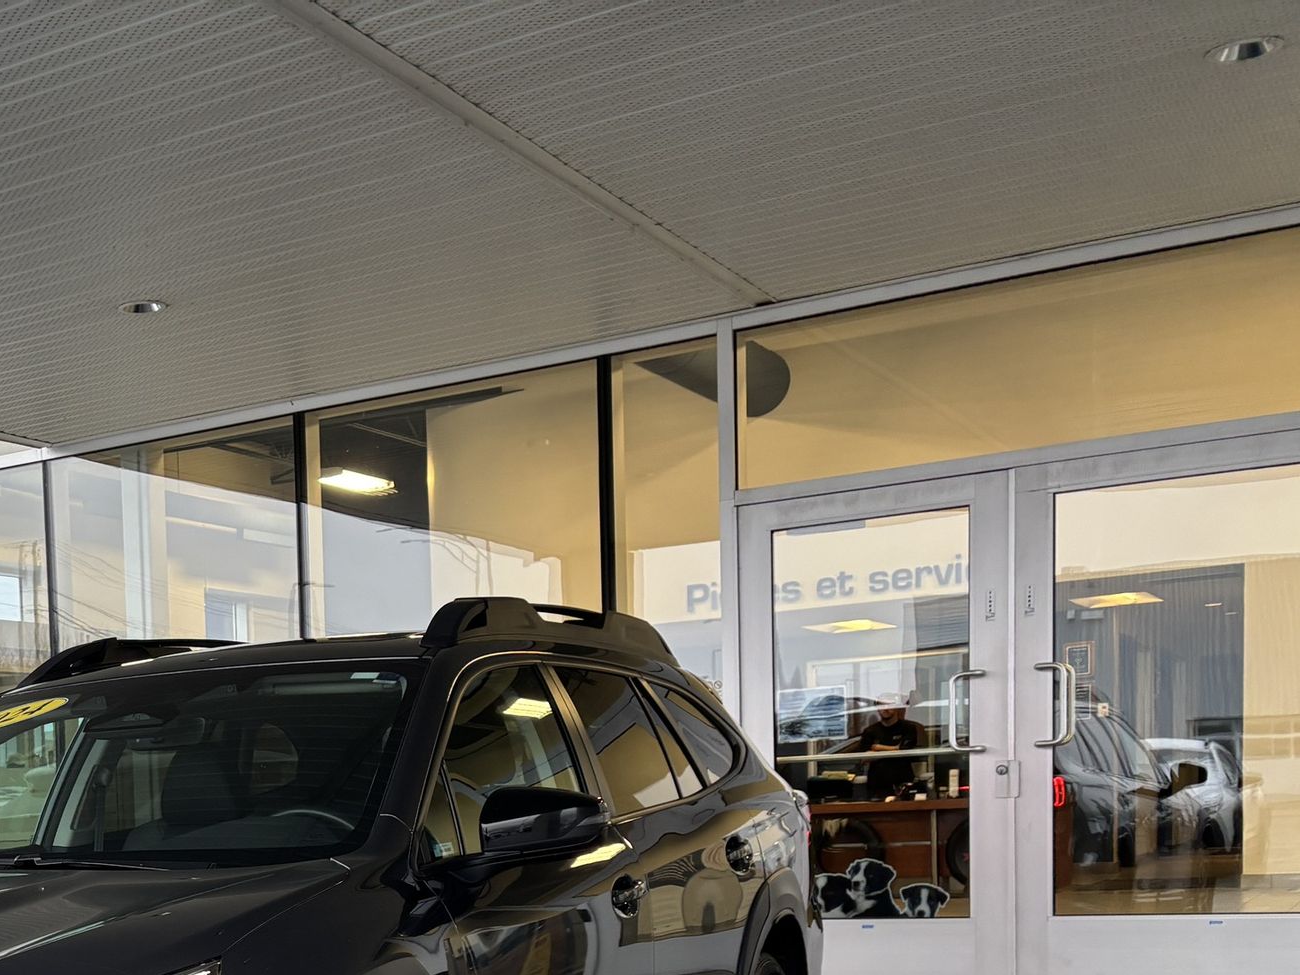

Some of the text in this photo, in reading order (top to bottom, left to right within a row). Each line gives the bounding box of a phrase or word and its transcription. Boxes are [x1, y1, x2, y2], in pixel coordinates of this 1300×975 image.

[686, 554, 969, 613] Pis et servi
